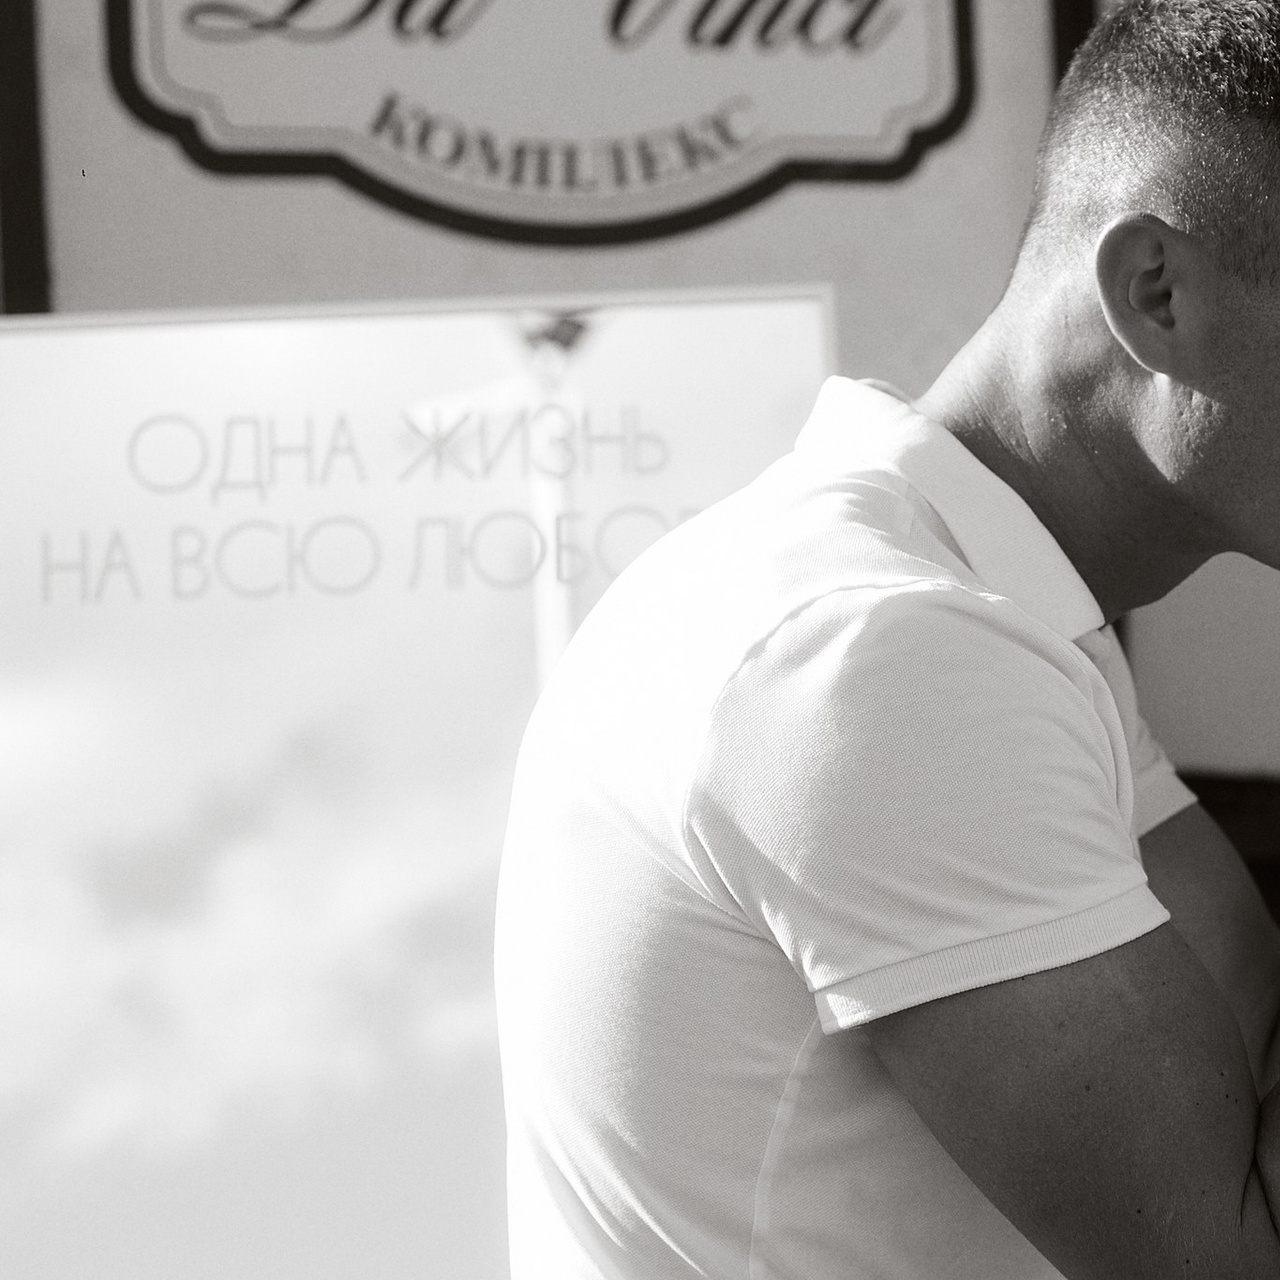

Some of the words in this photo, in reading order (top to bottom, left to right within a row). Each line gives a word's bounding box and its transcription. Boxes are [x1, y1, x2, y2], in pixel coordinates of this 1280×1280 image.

[370, 93, 757, 193] КОМПЛЕКС
[128, 414, 367, 503] ОДНА
[398, 404, 671, 481] ЖИЗНЬ
[43, 530, 141, 603] НА
[173, 516, 381, 599] ВСЮ
[409, 507, 704, 589] ЛЮБО
